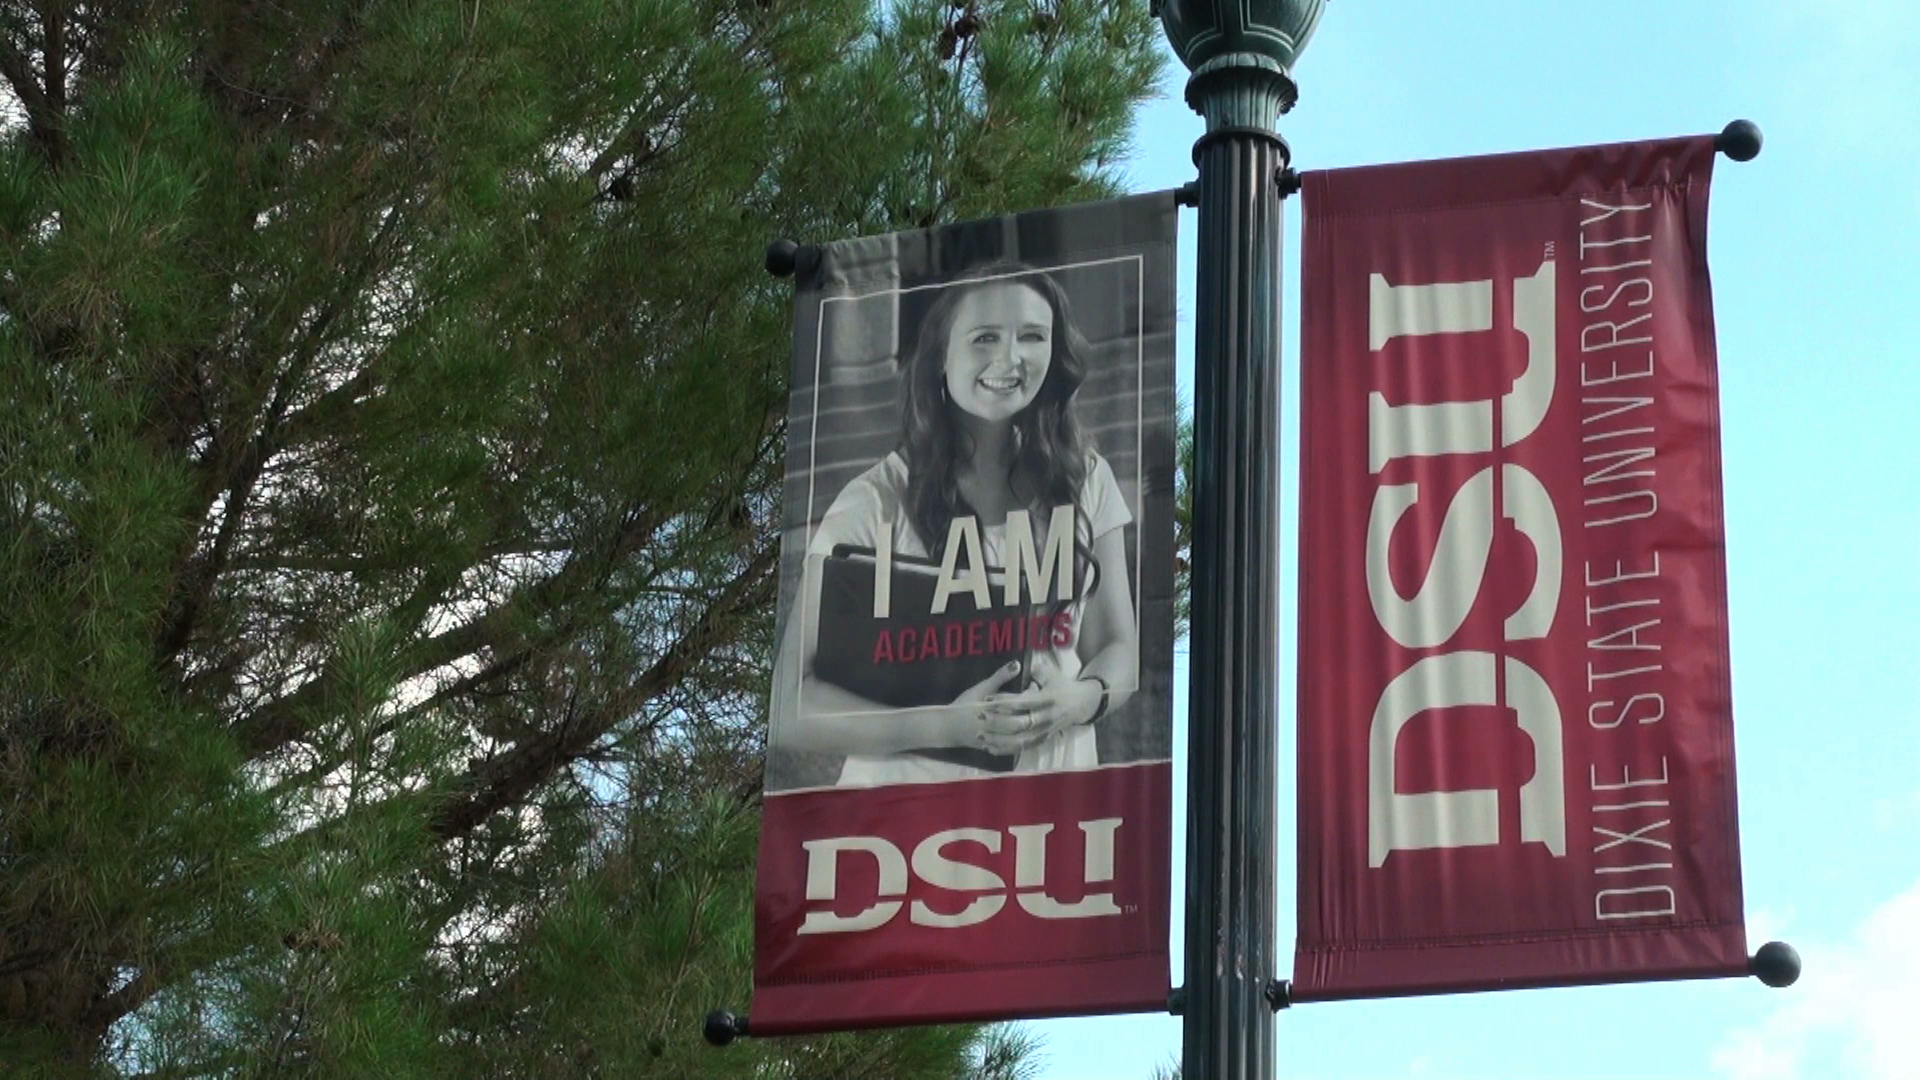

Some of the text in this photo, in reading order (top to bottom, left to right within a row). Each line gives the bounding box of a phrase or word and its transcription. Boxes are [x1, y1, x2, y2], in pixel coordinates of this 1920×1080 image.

[873, 503, 1075, 618] I AM
[1365, 260, 1567, 869] DSU
[1579, 197, 1676, 920] DIXIE STATE UNIVERSITY
[873, 611, 1074, 666] ACADEMICS
[796, 816, 1124, 936] DSU
